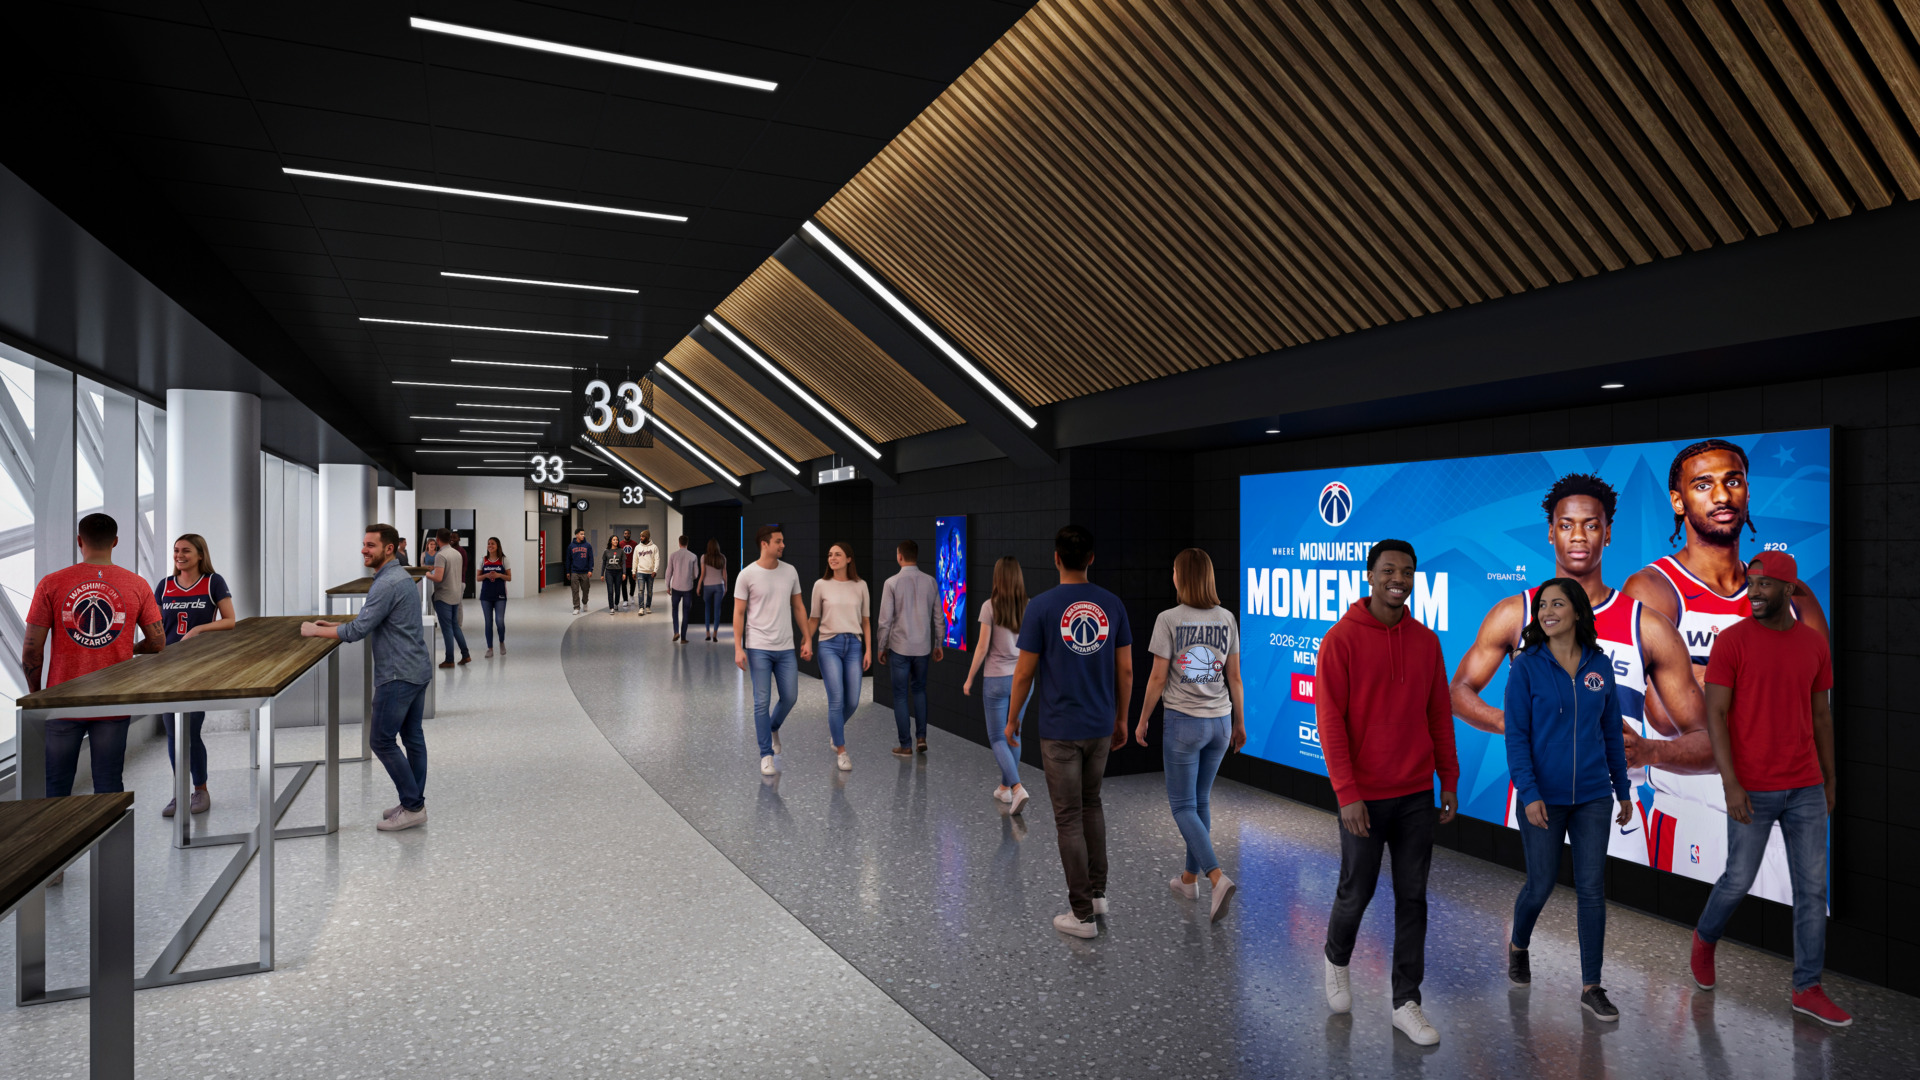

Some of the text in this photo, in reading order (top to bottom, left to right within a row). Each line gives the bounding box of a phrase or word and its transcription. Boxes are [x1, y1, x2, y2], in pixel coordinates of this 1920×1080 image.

[583, 379, 645, 434] 33
[530, 455, 565, 484] 33
[622, 485, 644, 505] 33
[1272, 547, 1295, 556] WHERE
[1763, 542, 1788, 552] #20
[1487, 573, 1527, 581] DYBANTSA
[69, 582, 118, 600] WASHINGTON
[162, 598, 206, 610] wizards
[1065, 603, 1104, 618] WASHINGTON
[177, 612, 188, 635] 6
[73, 631, 113, 647] WIZARDS
[1071, 642, 1100, 653] WIZARDS
[1175, 625, 1229, 656] WIZARDS
[1269, 632, 1311, 649] 2026-27
[1299, 680, 1313, 697] ON
